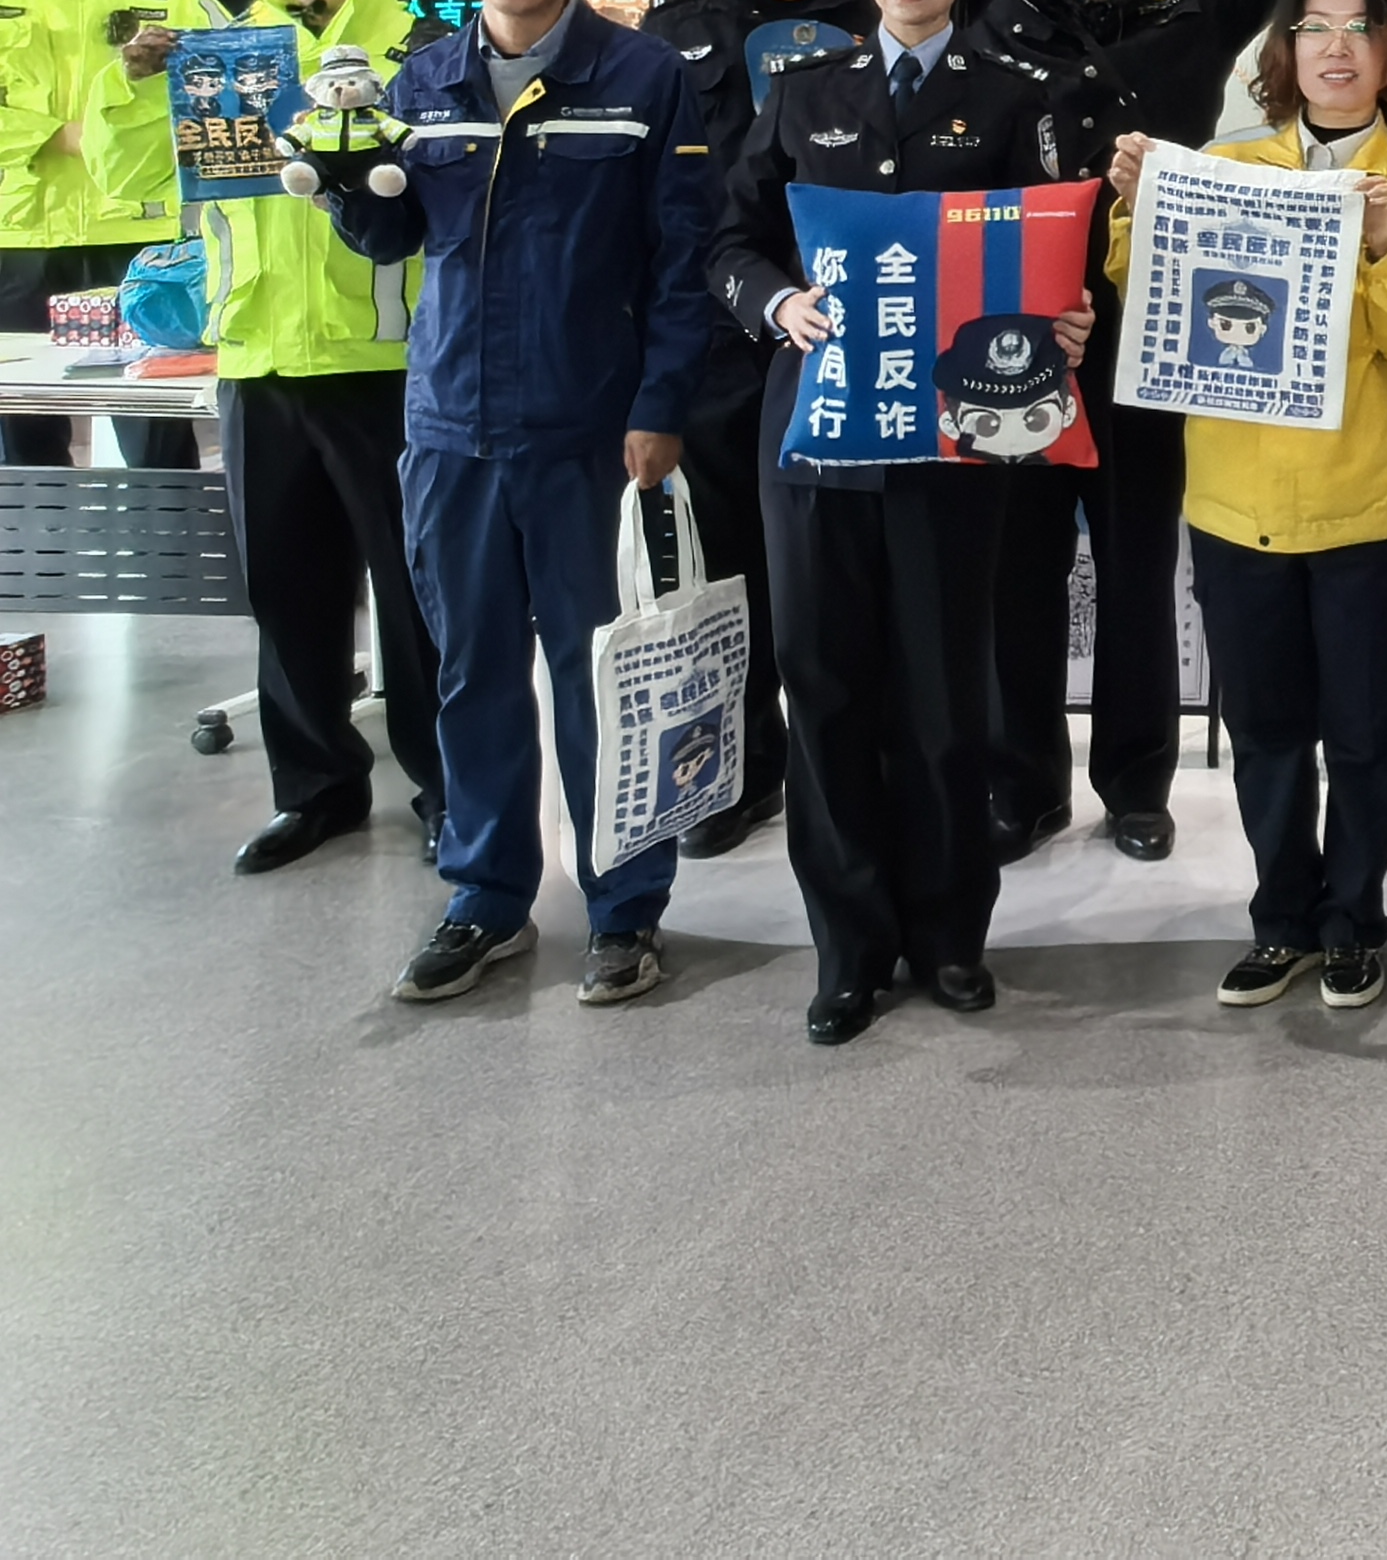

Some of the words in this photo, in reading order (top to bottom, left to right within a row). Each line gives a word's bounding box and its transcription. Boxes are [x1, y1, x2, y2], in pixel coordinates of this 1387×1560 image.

[947, 205, 1021, 224] 96110
[875, 242, 918, 441] 全民反诈
